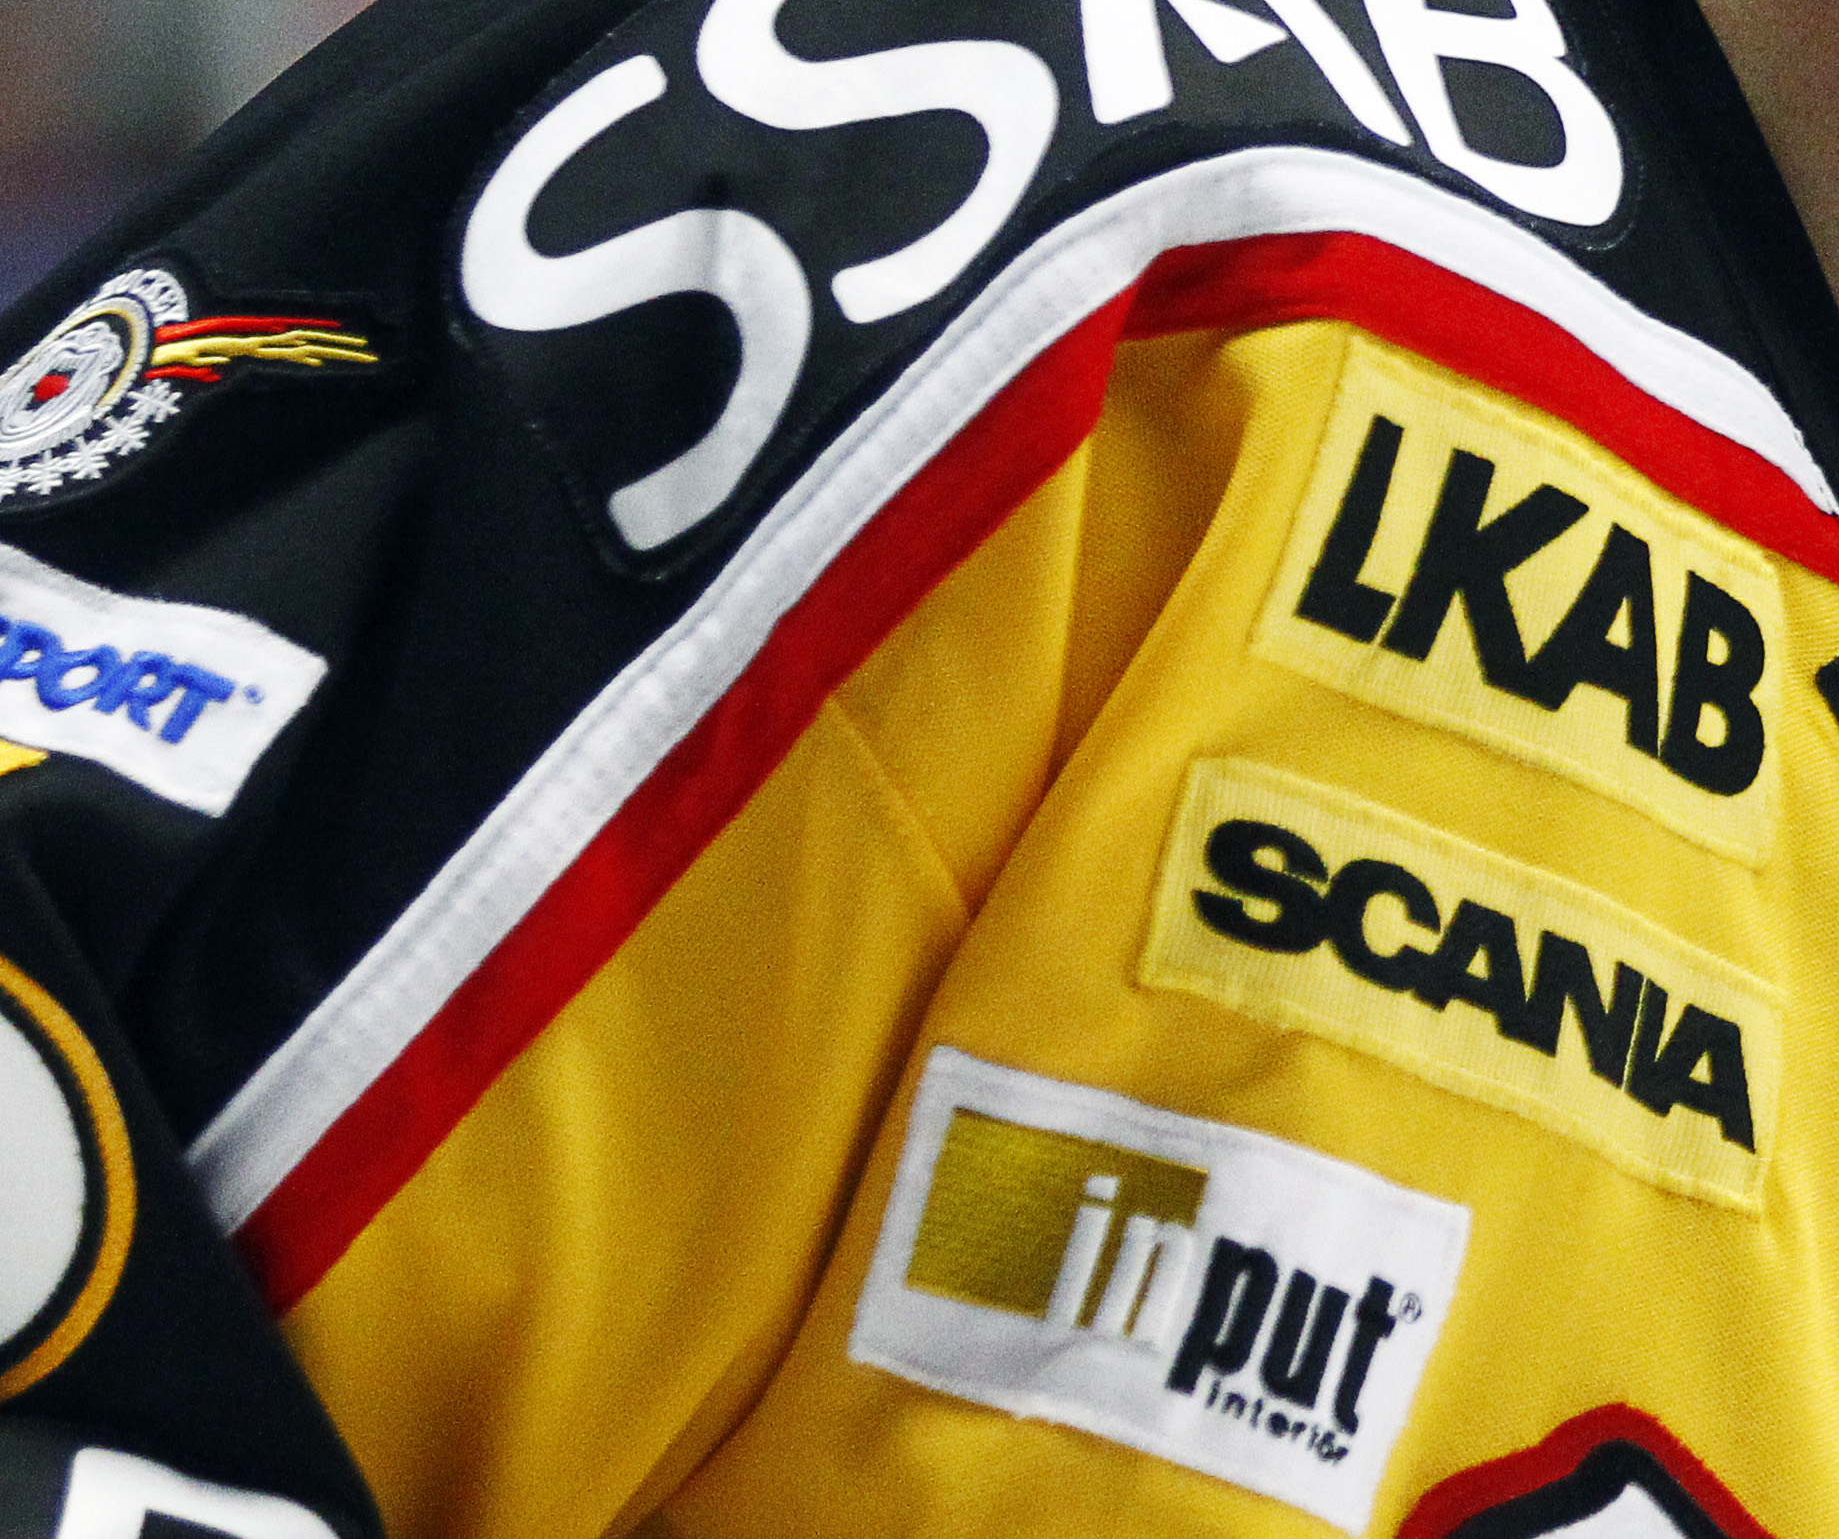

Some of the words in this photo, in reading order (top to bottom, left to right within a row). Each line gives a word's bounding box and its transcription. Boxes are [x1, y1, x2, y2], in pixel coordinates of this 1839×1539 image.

[0, 615, 236, 744] PORT
[1293, 414, 1767, 797] LKAB
[1192, 819, 1756, 1153] SCANIA
